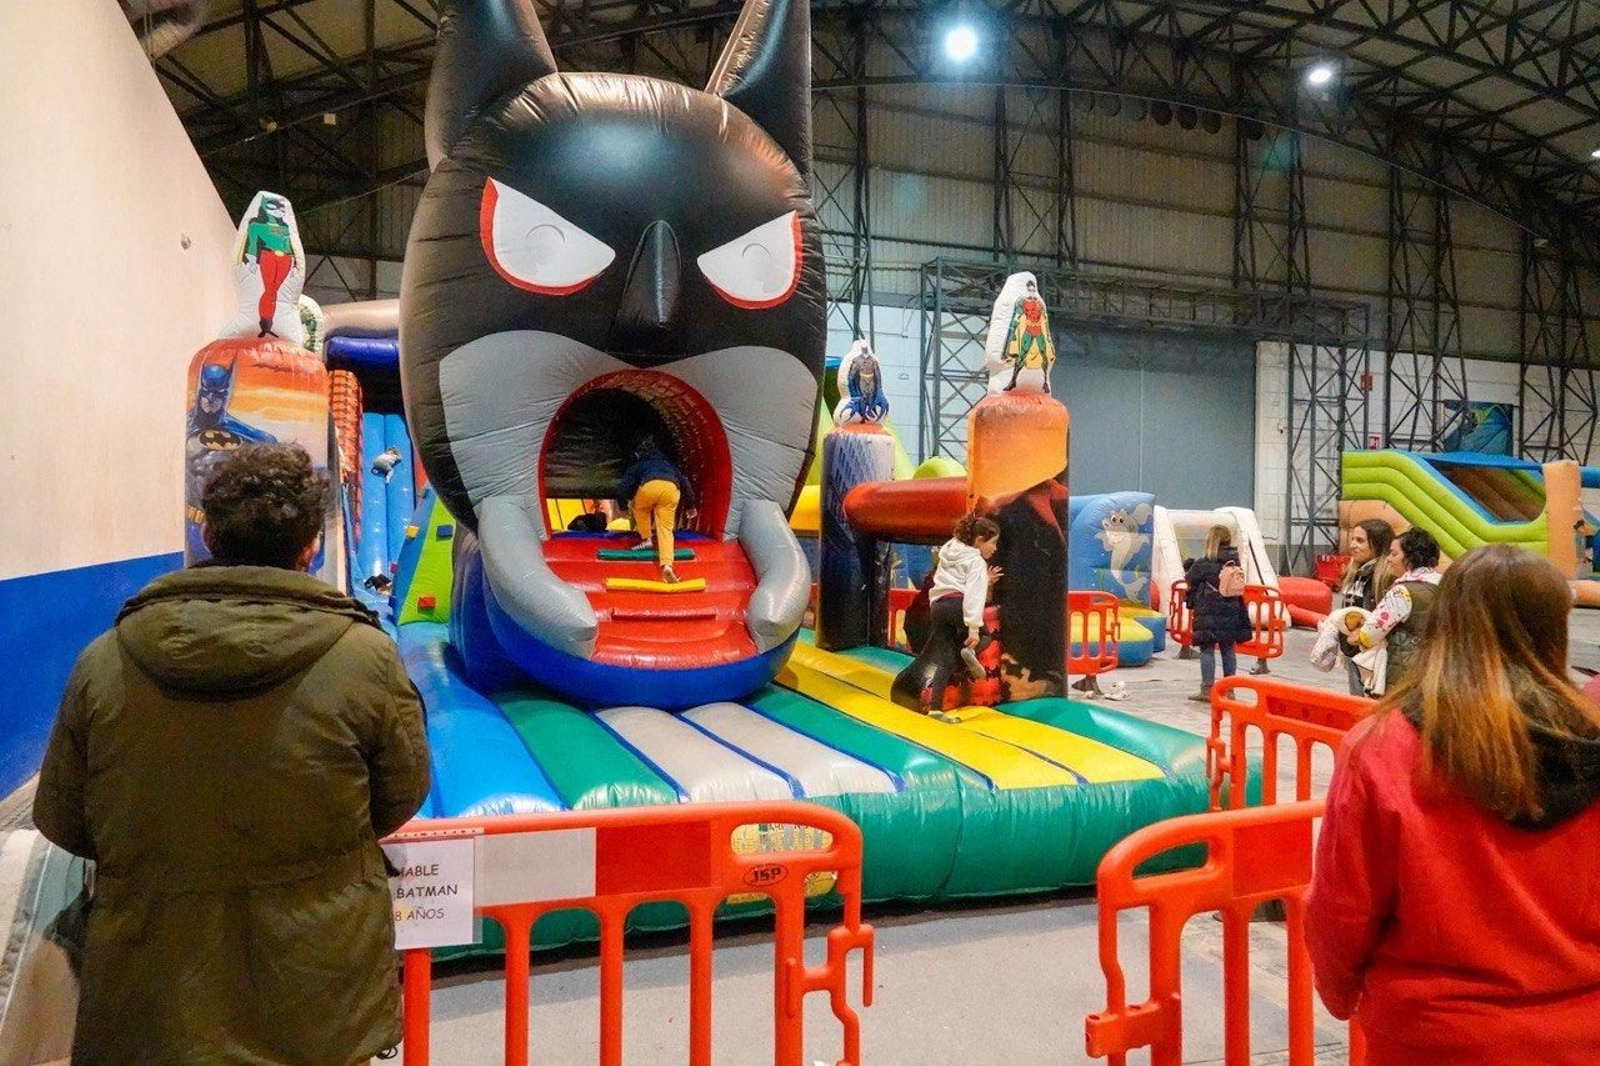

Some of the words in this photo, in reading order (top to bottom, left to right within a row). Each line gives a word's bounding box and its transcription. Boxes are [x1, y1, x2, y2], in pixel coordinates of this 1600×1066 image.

[750, 867, 781, 881] JSP
[396, 884, 458, 898] BATMAN
[407, 906, 445, 920] AÑOS
